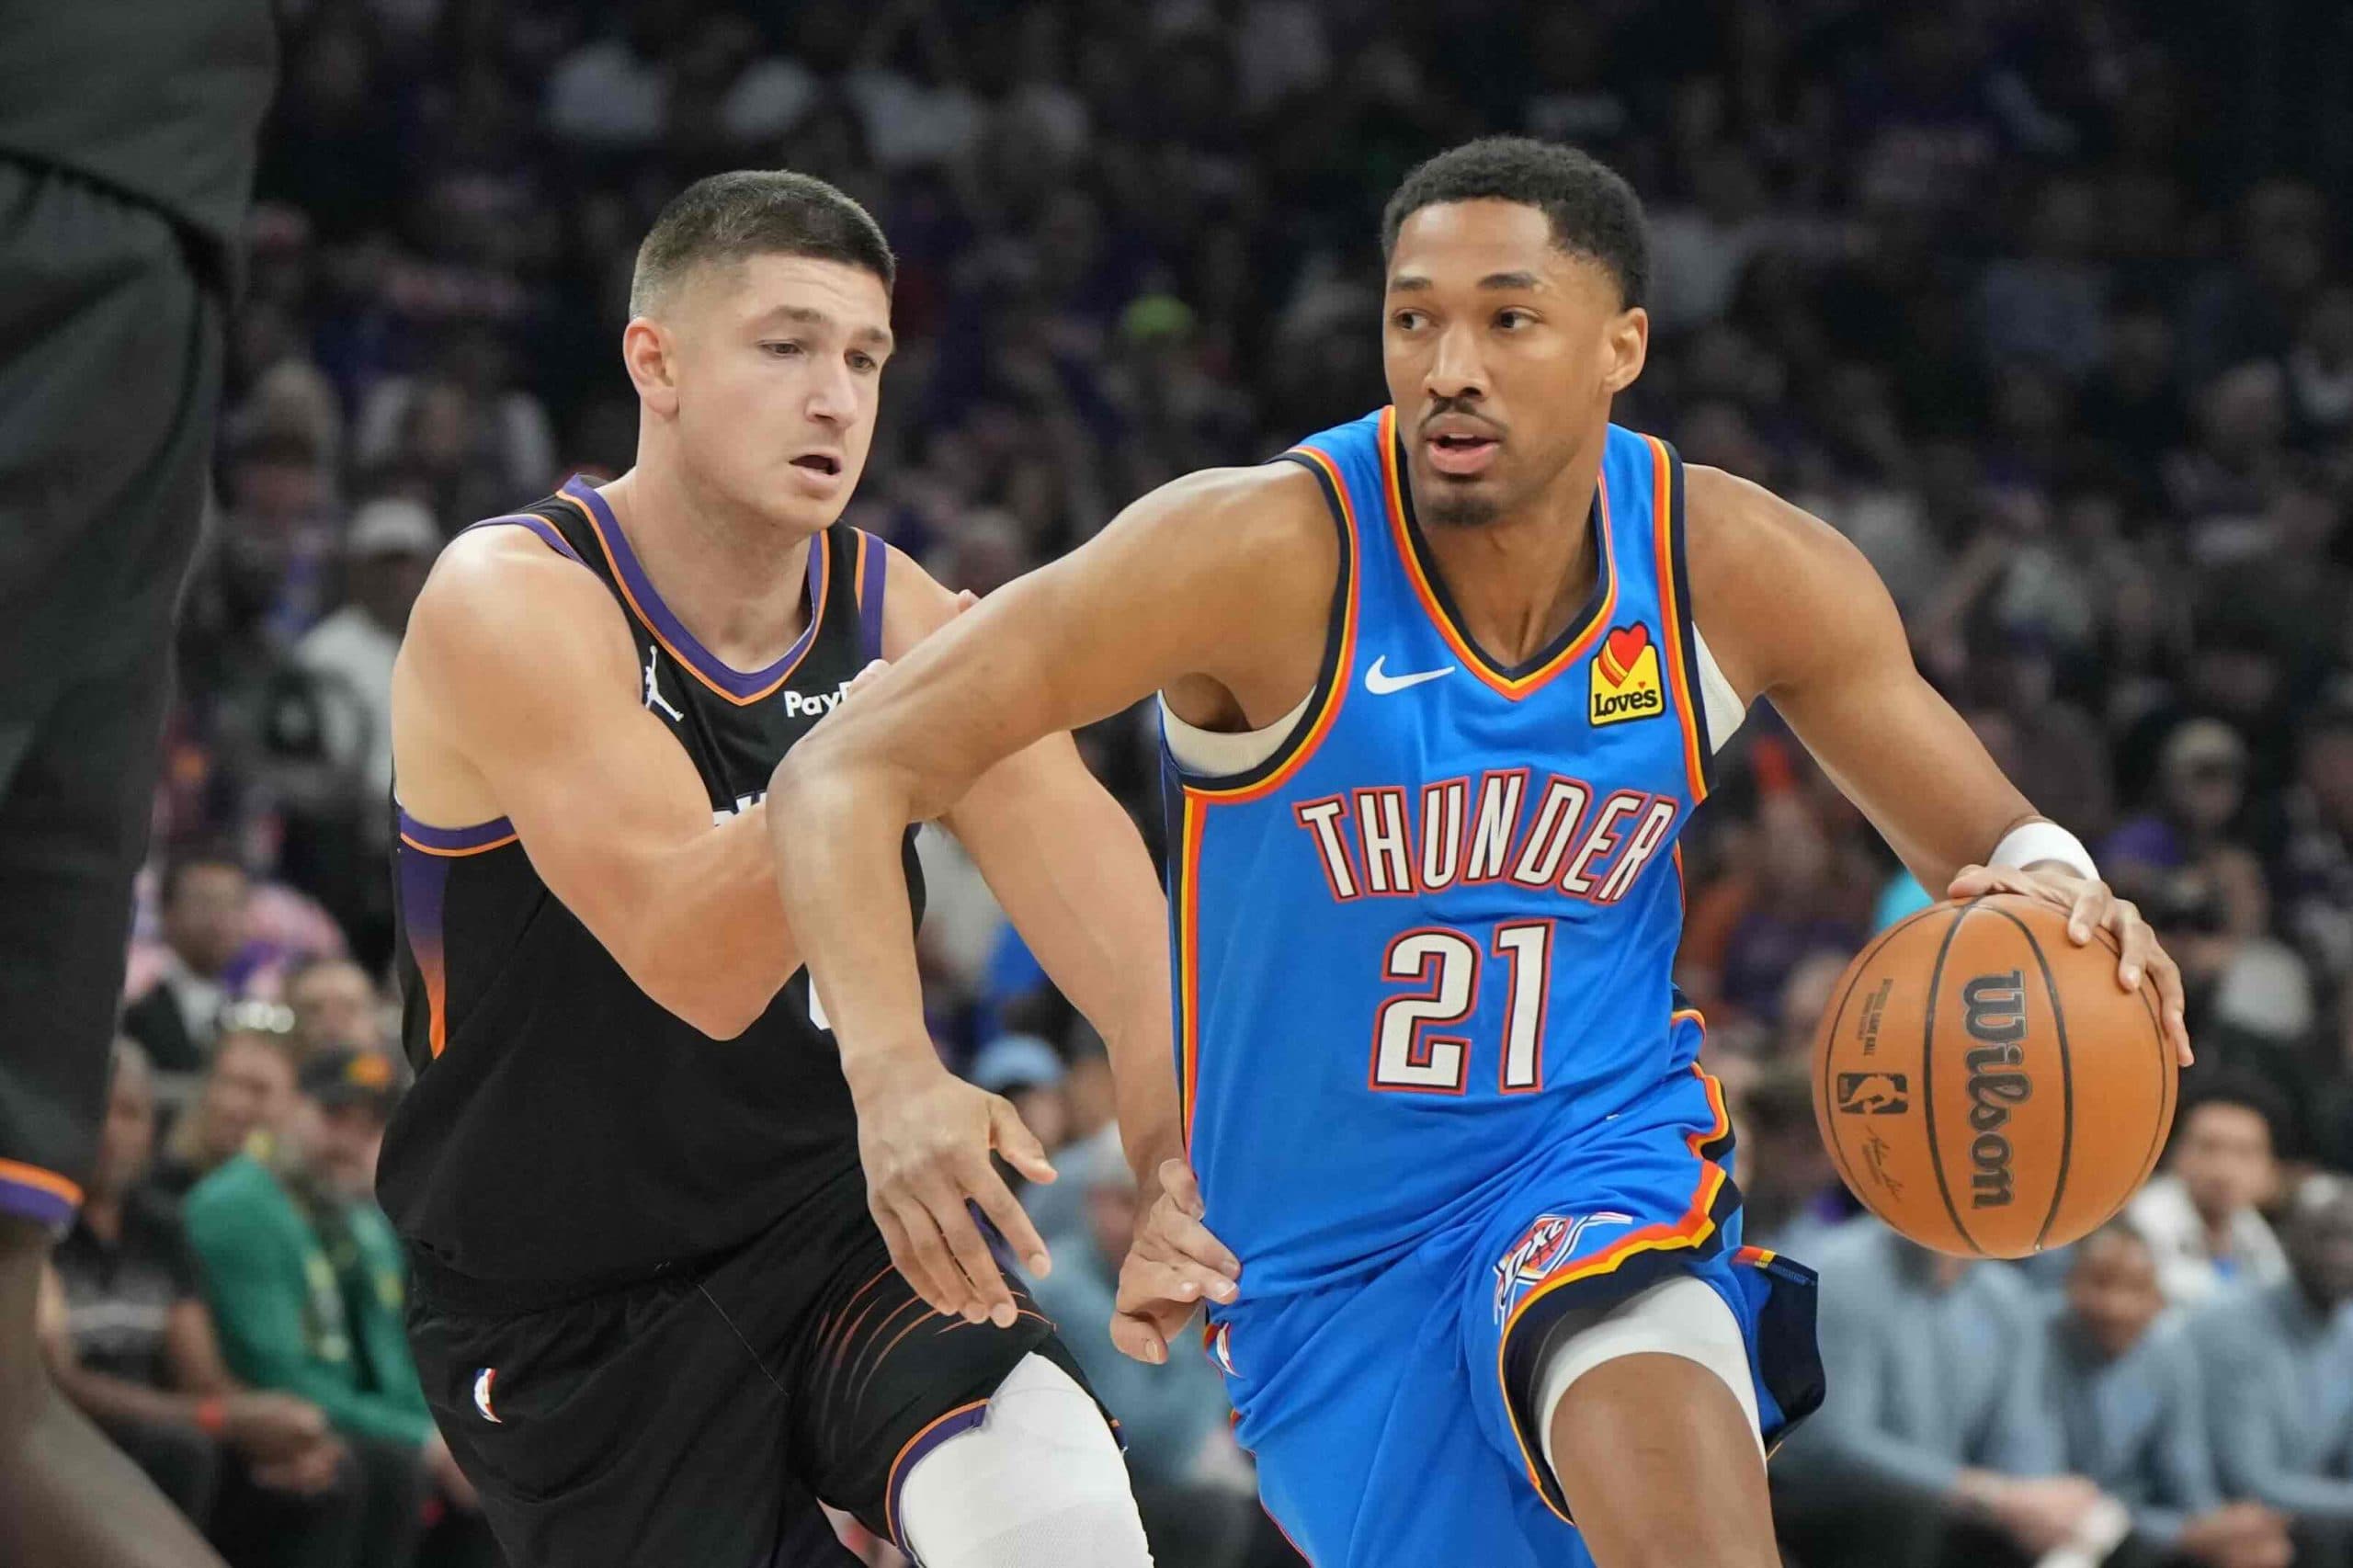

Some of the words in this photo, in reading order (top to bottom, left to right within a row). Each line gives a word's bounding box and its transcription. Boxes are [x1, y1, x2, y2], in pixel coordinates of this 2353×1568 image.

[1292, 767, 1679, 906] THUNDER
[1368, 917, 1557, 1096] 21
[1962, 970, 2031, 1210] Wilson
